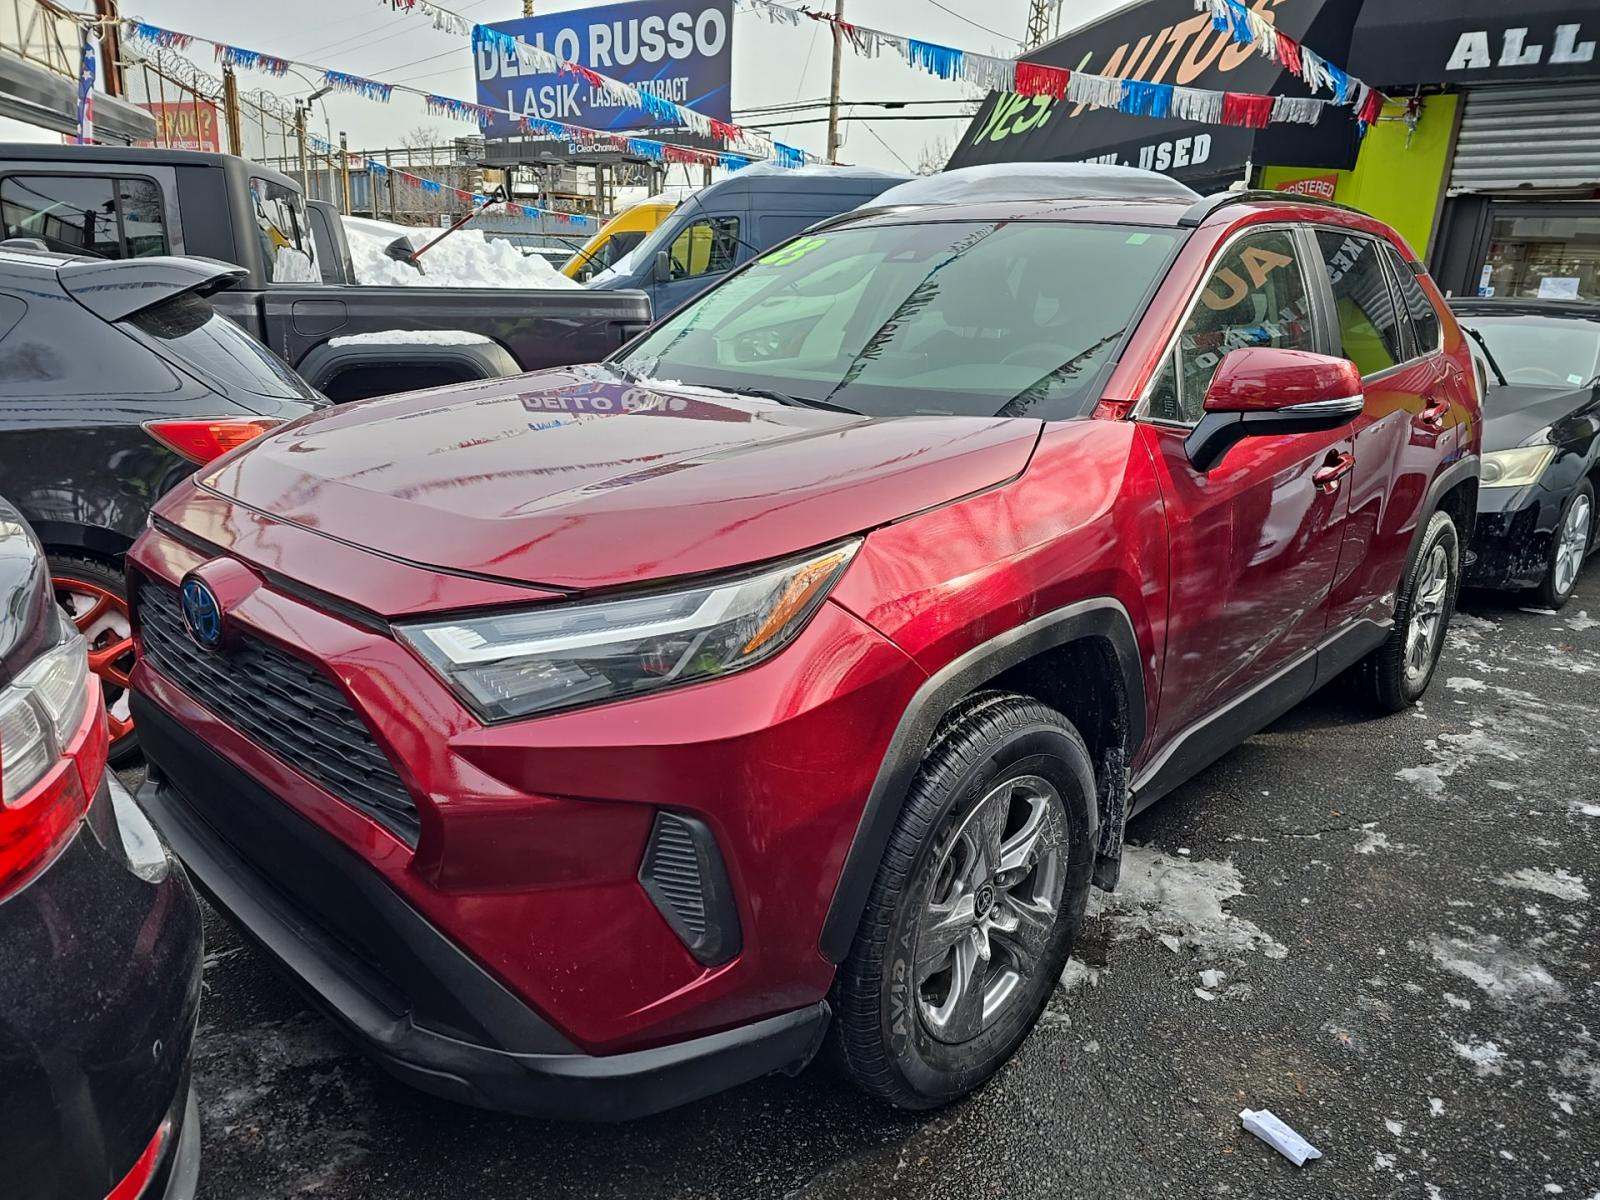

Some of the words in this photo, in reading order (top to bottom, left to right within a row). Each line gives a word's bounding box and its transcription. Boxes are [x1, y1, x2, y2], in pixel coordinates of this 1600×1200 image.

[478, 28, 580, 81] DELLO
[589, 8, 726, 68] RUSSO
[1445, 23, 1597, 71] ALL
[508, 83, 582, 121] LASIK
[1138, 133, 1212, 171] USED
[1283, 181, 1335, 198] GISTERED
